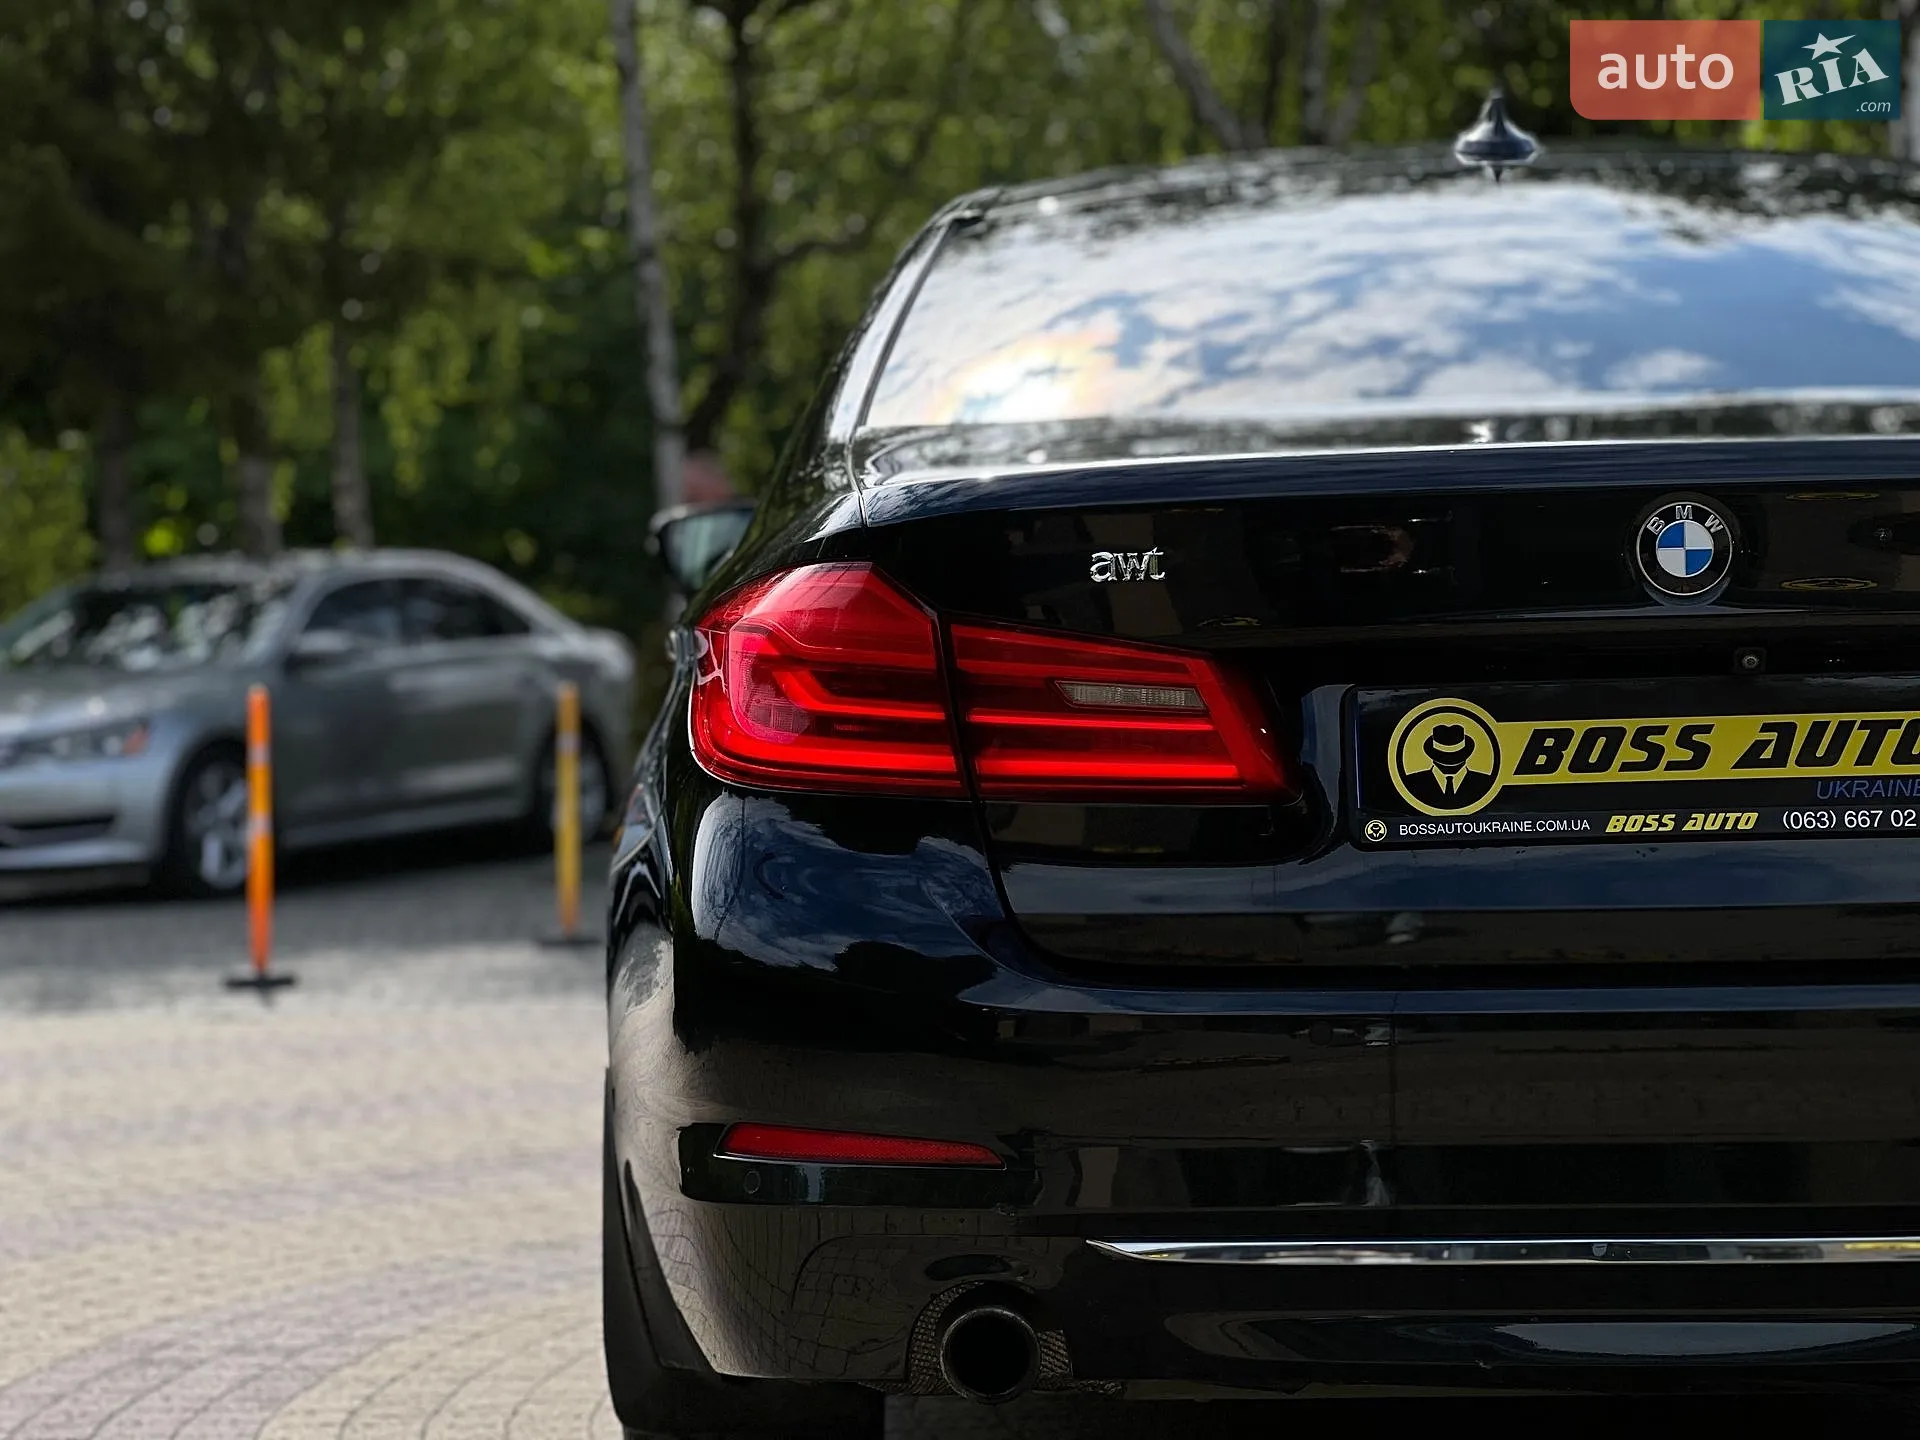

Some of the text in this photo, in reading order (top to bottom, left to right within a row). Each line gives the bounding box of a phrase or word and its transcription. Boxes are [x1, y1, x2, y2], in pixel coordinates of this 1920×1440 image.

[1646, 504, 1724, 536] BMW
[1513, 718, 1920, 775] BOSS AUTO
[1399, 808, 1917, 836] BOSSAUTOUKRAINE.COM.UA BOSS AUTO (063) 667 02
